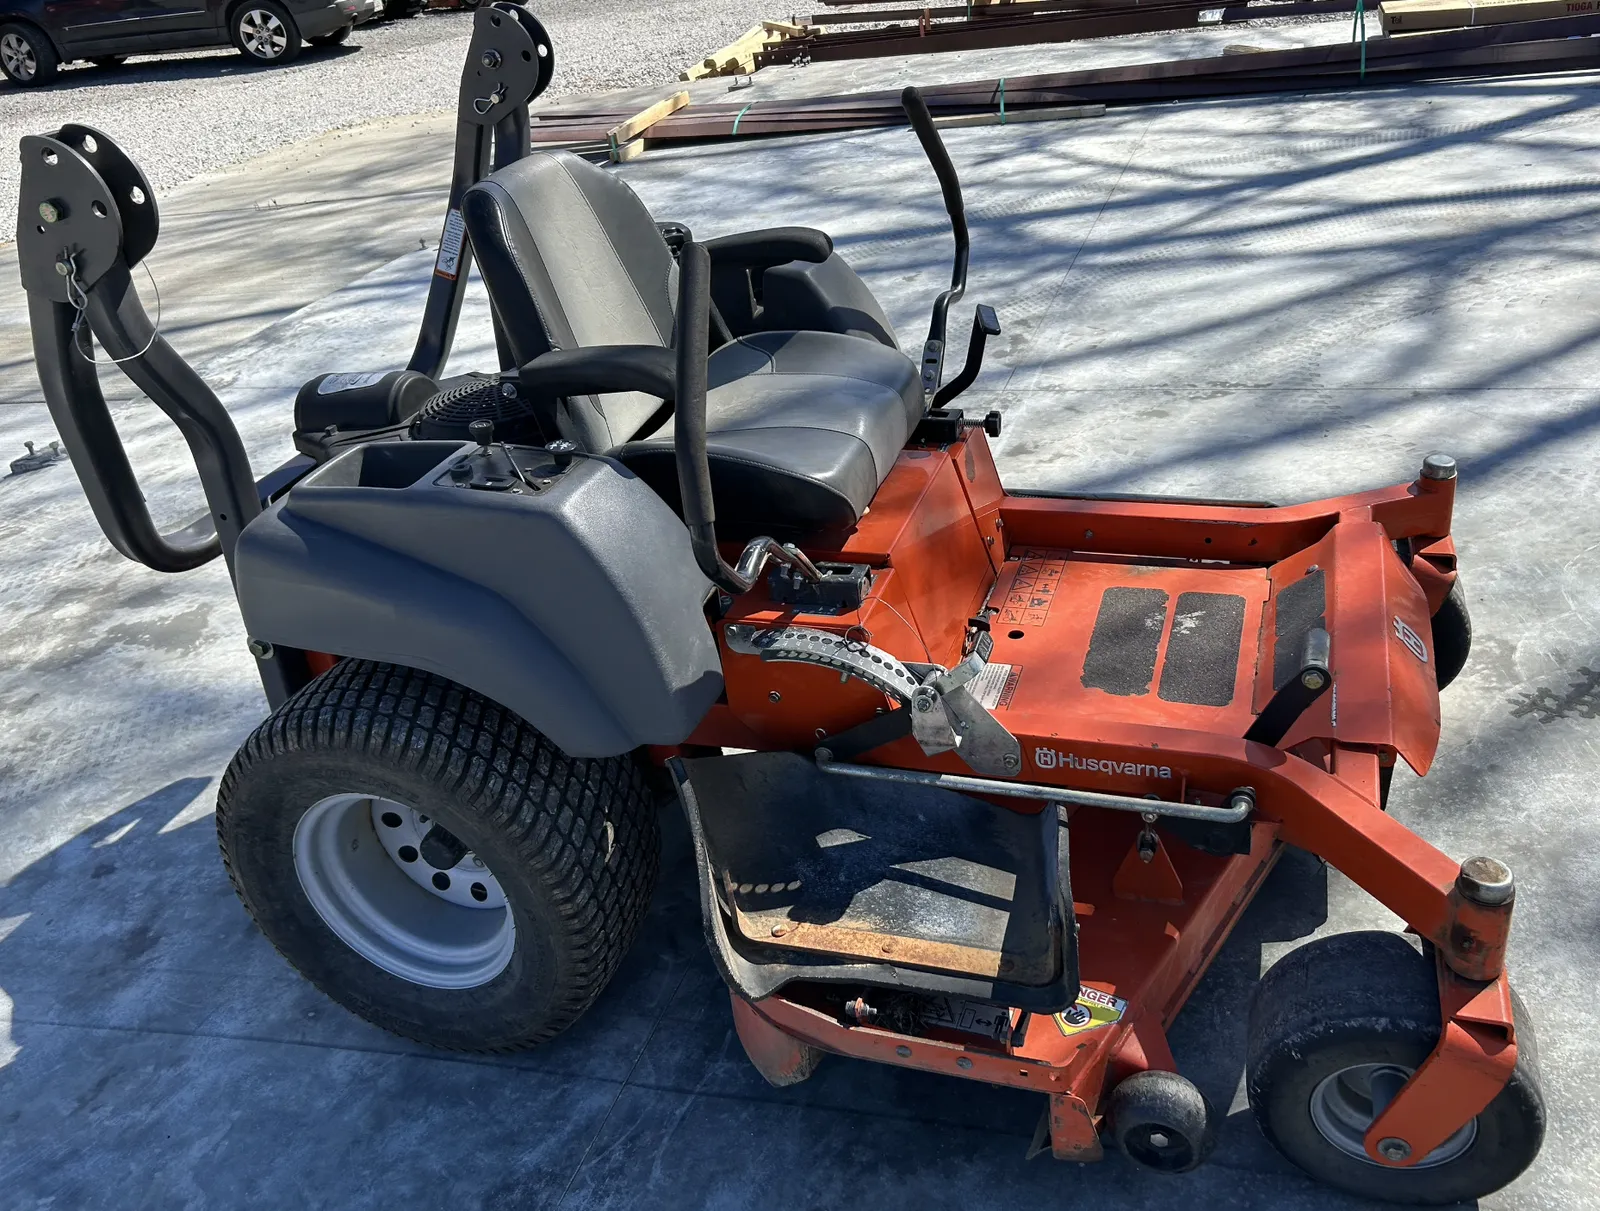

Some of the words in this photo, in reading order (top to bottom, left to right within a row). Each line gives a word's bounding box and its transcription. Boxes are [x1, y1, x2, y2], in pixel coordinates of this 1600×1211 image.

[1566, 2, 1593, 12] TIOGA
[1058, 752, 1172, 779] Husqvarna
[1080, 987, 1118, 1007] NGER
